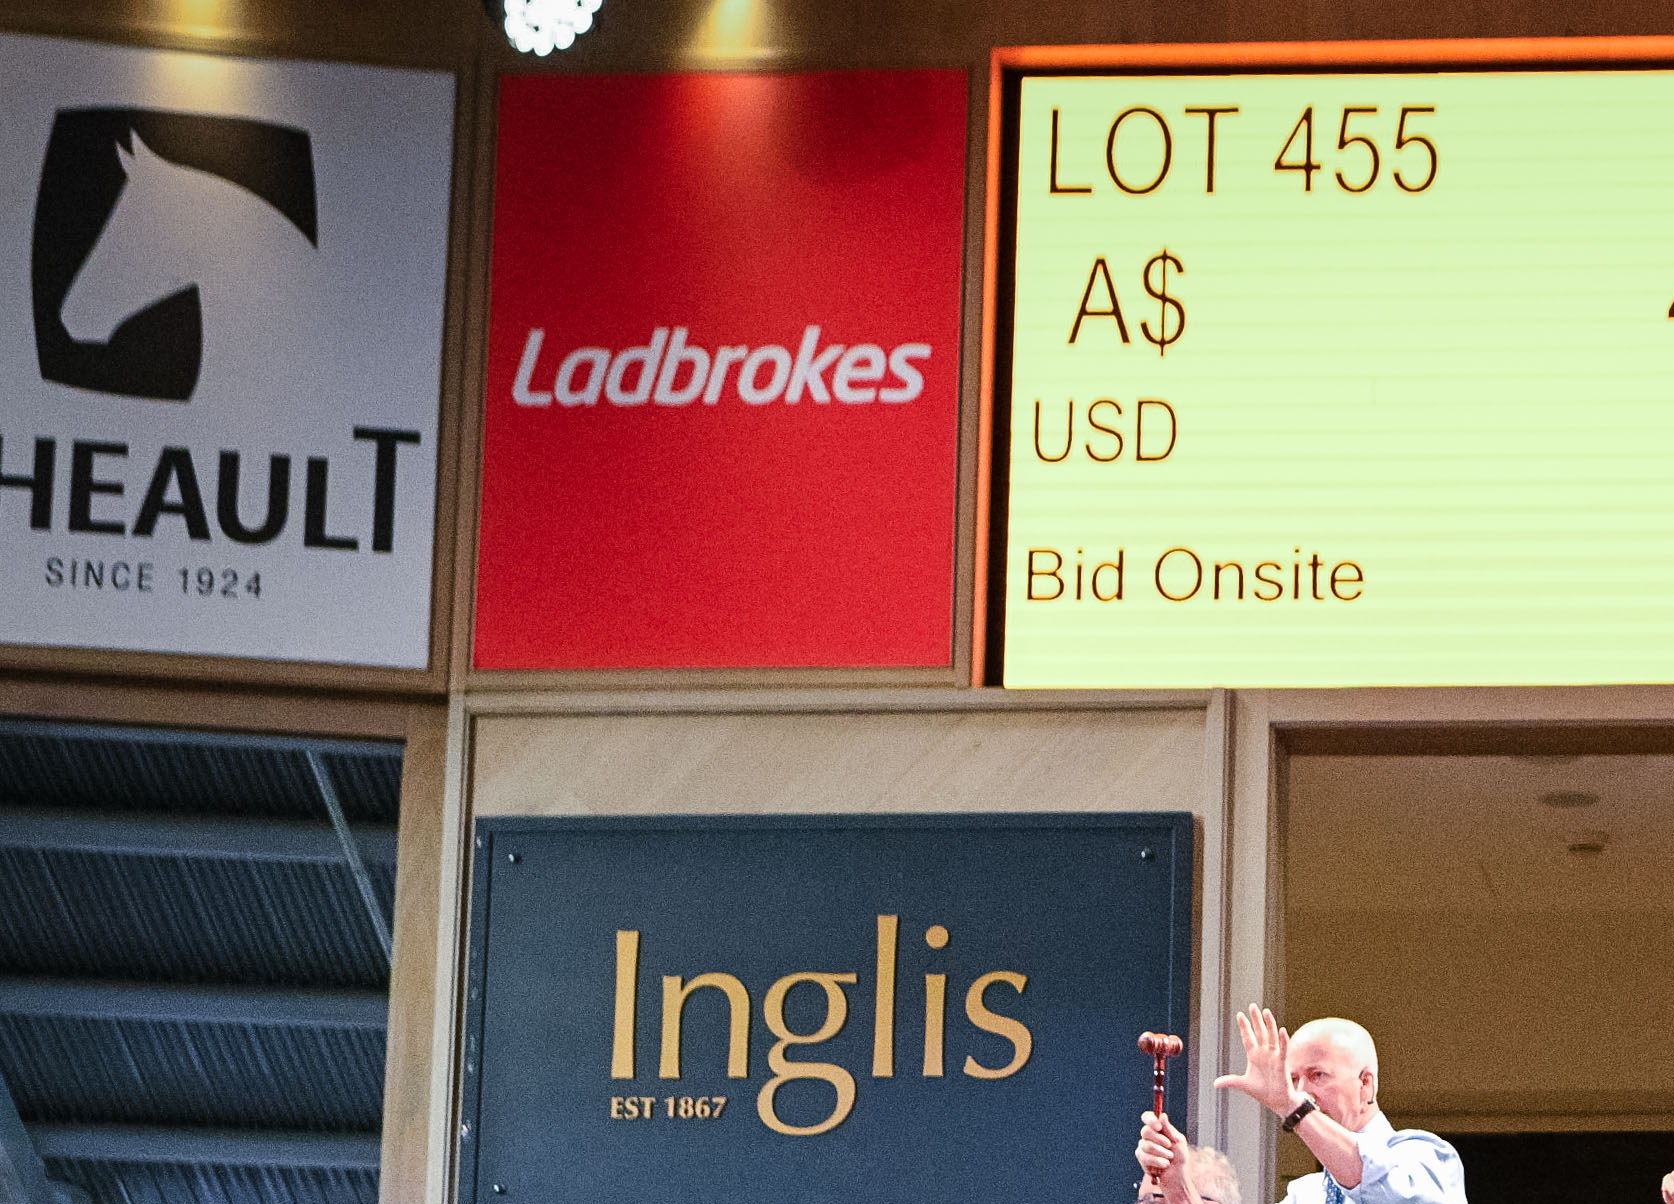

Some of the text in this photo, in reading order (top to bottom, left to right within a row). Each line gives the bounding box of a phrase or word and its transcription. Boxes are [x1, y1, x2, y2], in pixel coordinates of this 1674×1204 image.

[1048, 105, 1439, 195] LOT 455
[1068, 249, 1187, 356] A$
[512, 324, 933, 407] Ladbrokes
[1032, 399, 1178, 464] USD
[44, 556, 262, 600] SINCE 1924
[1026, 548, 1365, 603] Bid Onsite
[610, 914, 1033, 1136] Inglis
[609, 1095, 727, 1120] EST 1867
